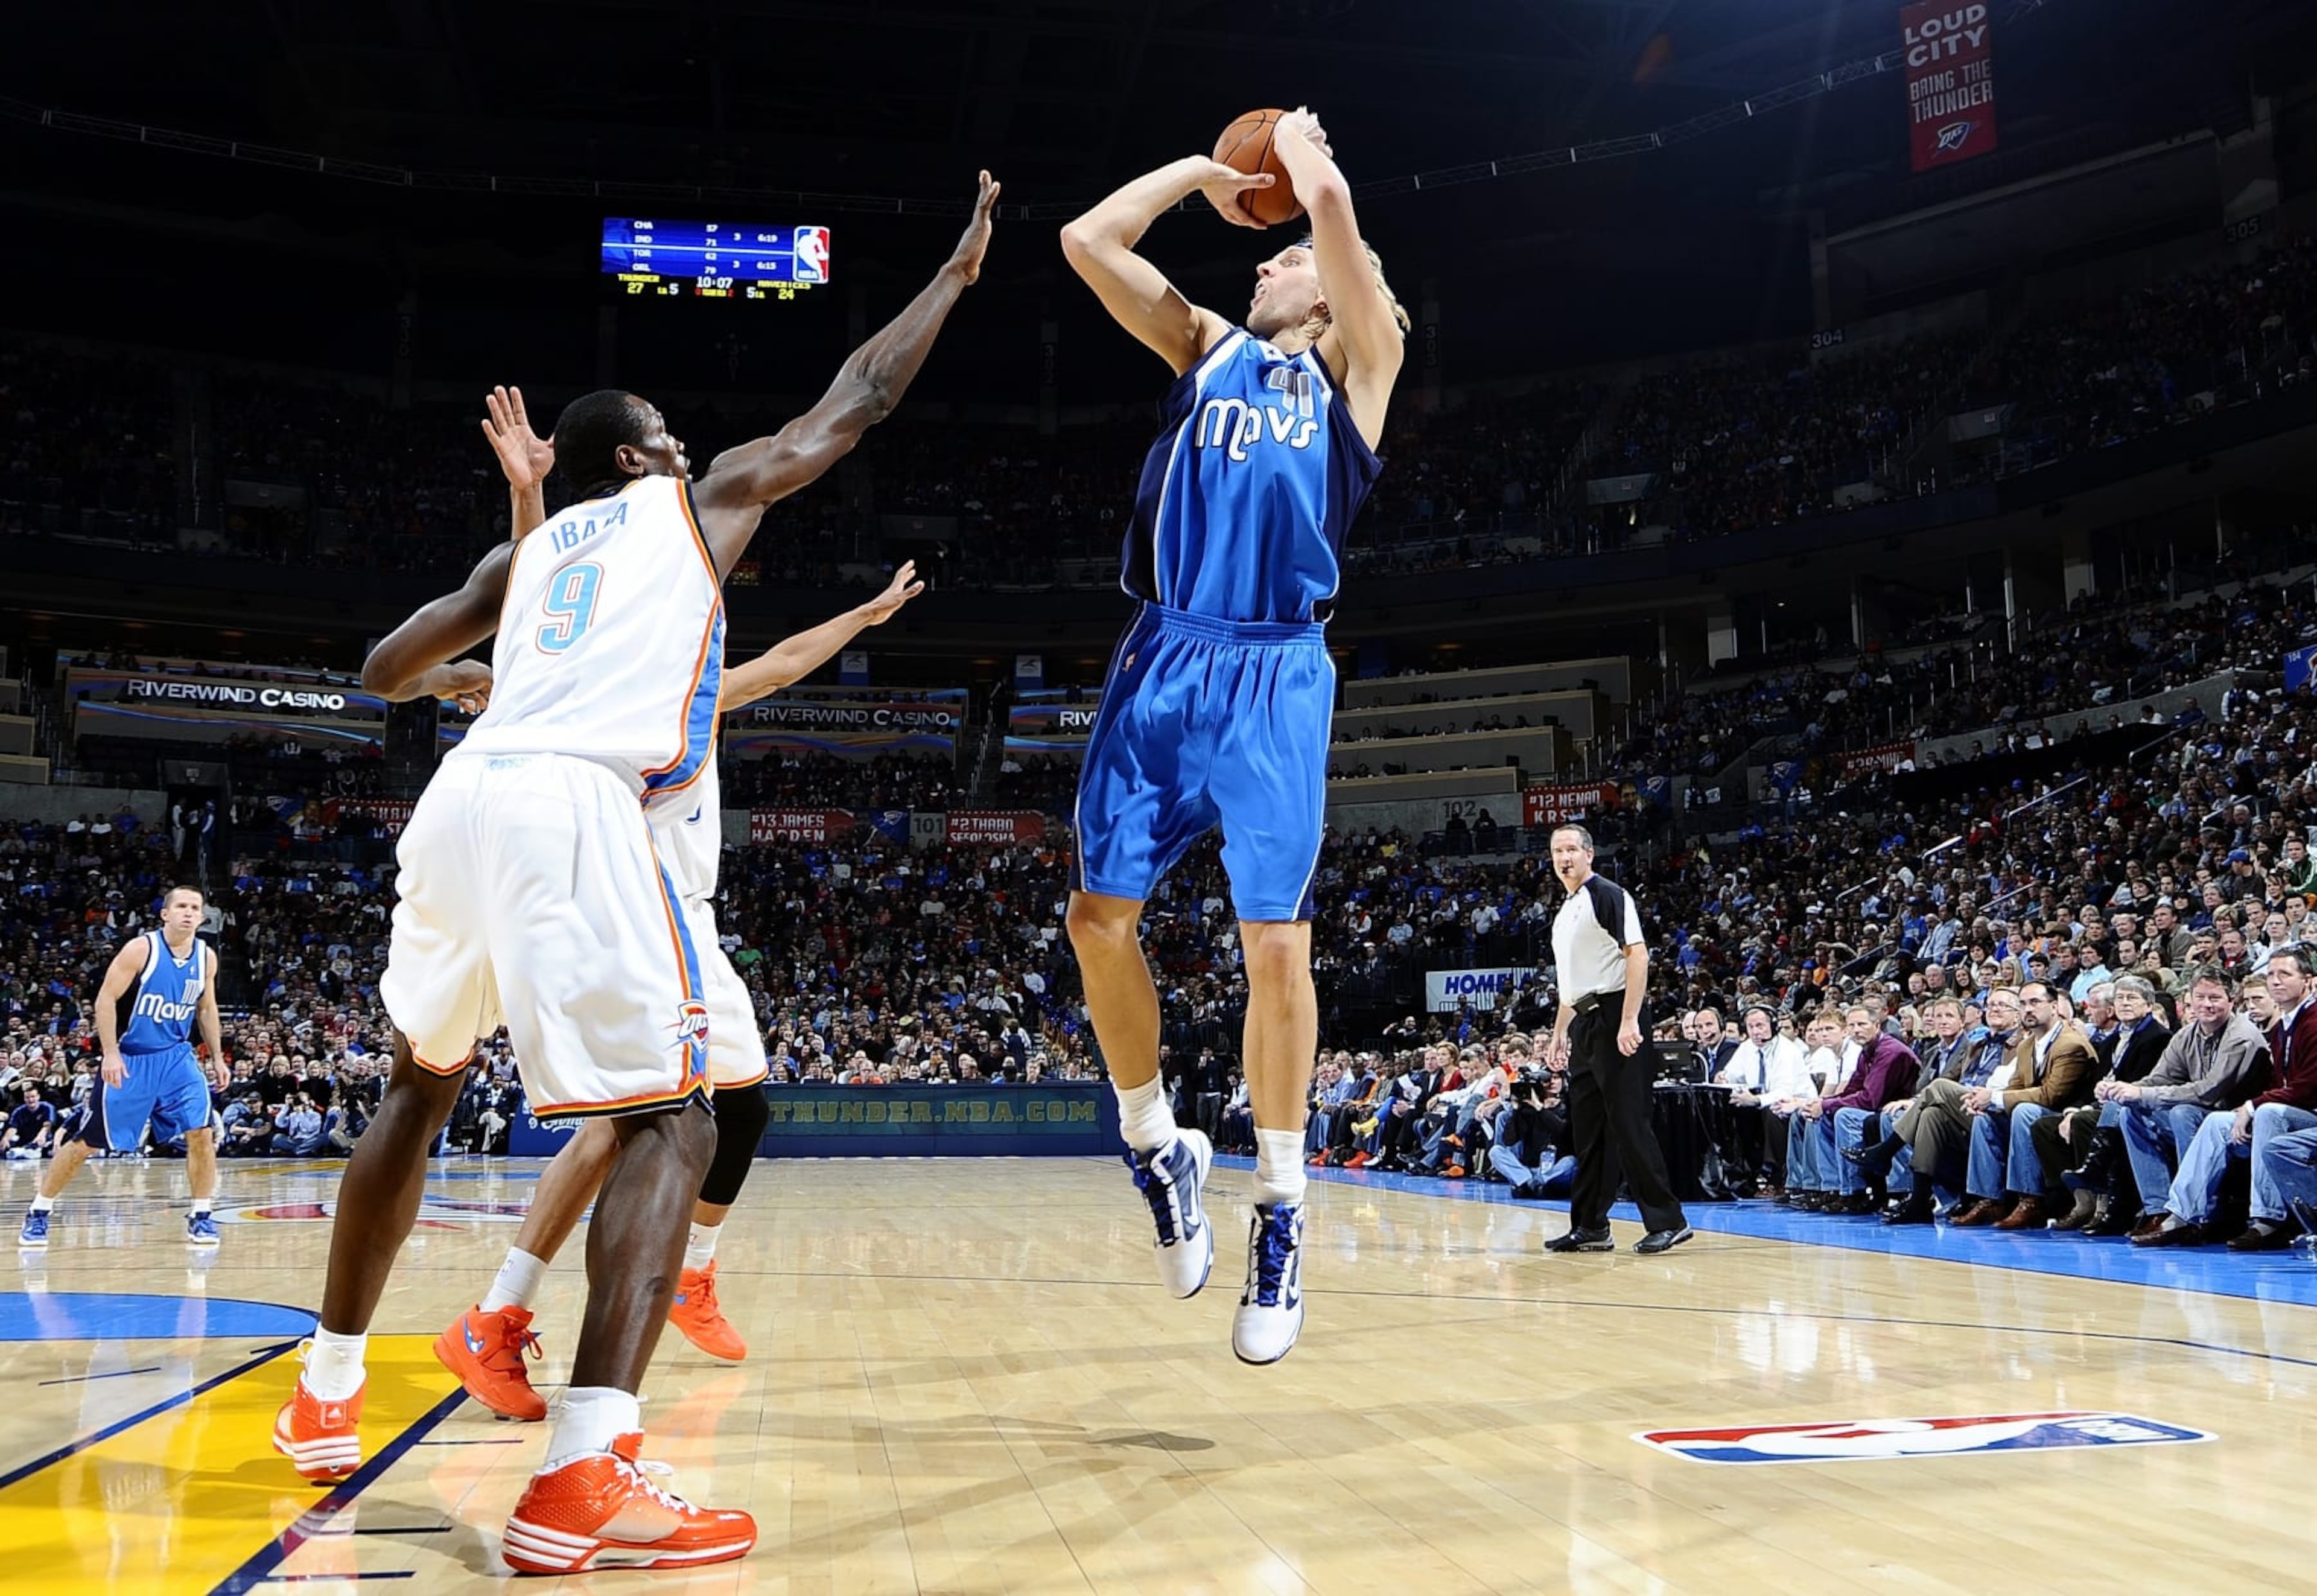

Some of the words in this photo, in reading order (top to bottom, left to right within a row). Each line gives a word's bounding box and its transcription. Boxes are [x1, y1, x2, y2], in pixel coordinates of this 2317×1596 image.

[1904, 4, 1986, 45] LOUD
[1907, 24, 1987, 67] CITY
[1910, 70, 1954, 101] BRING
[1961, 59, 1992, 84] THE
[1910, 80, 1993, 123] THUNDER
[627, 282, 644, 294] 27
[669, 283, 679, 296] 5
[746, 286, 756, 299] 5
[778, 288, 795, 300] 24
[1812, 329, 1843, 349] 304
[1268, 366, 1314, 419] 41
[551, 501, 629, 555] IBAA
[535, 561, 604, 655] 9
[127, 679, 256, 704] RIVERWIND
[259, 688, 346, 711] CASINO
[754, 706, 869, 723] RIVERWIND
[873, 709, 950, 725] CASINO
[1529, 793, 1554, 809] #12
[751, 813, 777, 828] #13
[778, 813, 825, 828] JAMES
[914, 818, 943, 834] 101
[950, 817, 970, 831] #2
[971, 817, 1014, 832] THABO
[768, 1101, 1096, 1123] THUNDER.NBA.COM
